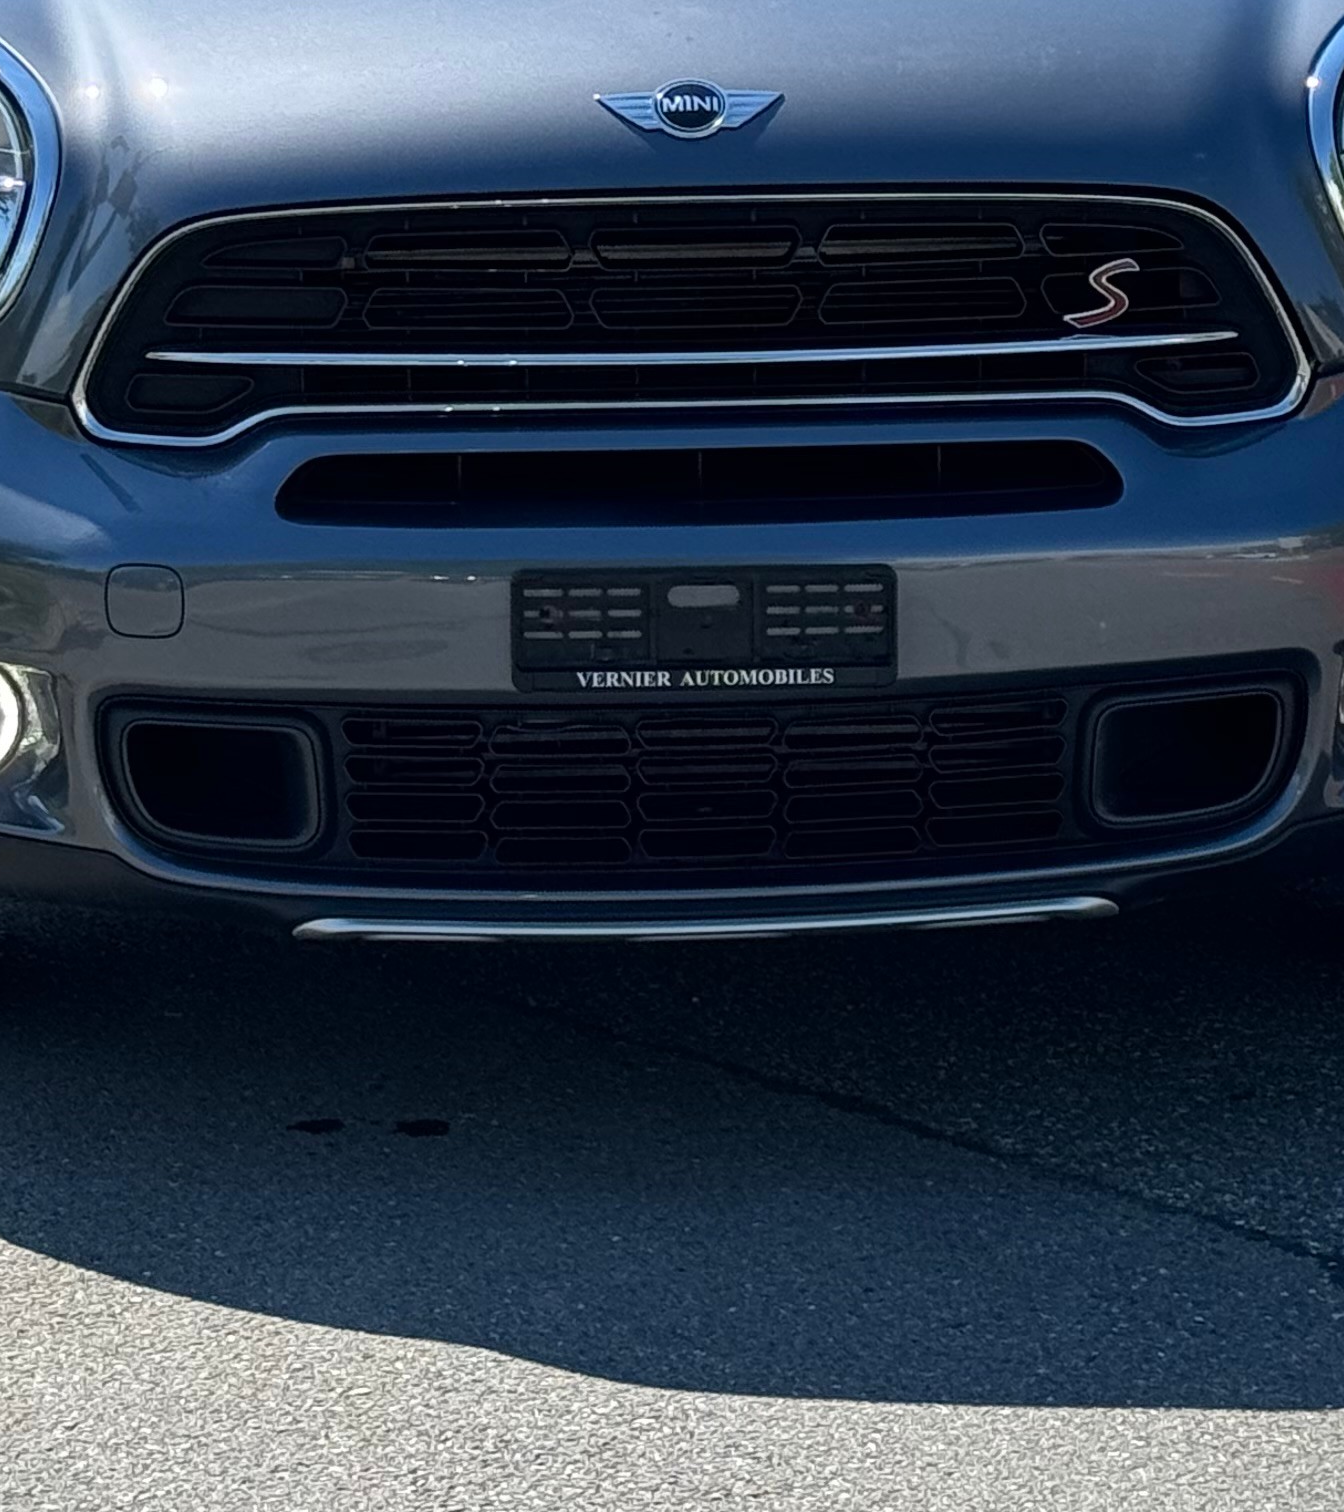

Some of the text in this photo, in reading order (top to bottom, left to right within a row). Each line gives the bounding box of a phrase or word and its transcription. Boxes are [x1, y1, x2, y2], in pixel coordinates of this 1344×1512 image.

[661, 94, 720, 113] MINI
[1063, 257, 1141, 329] S
[576, 668, 835, 688] VERNIER AUTOMOBILES
